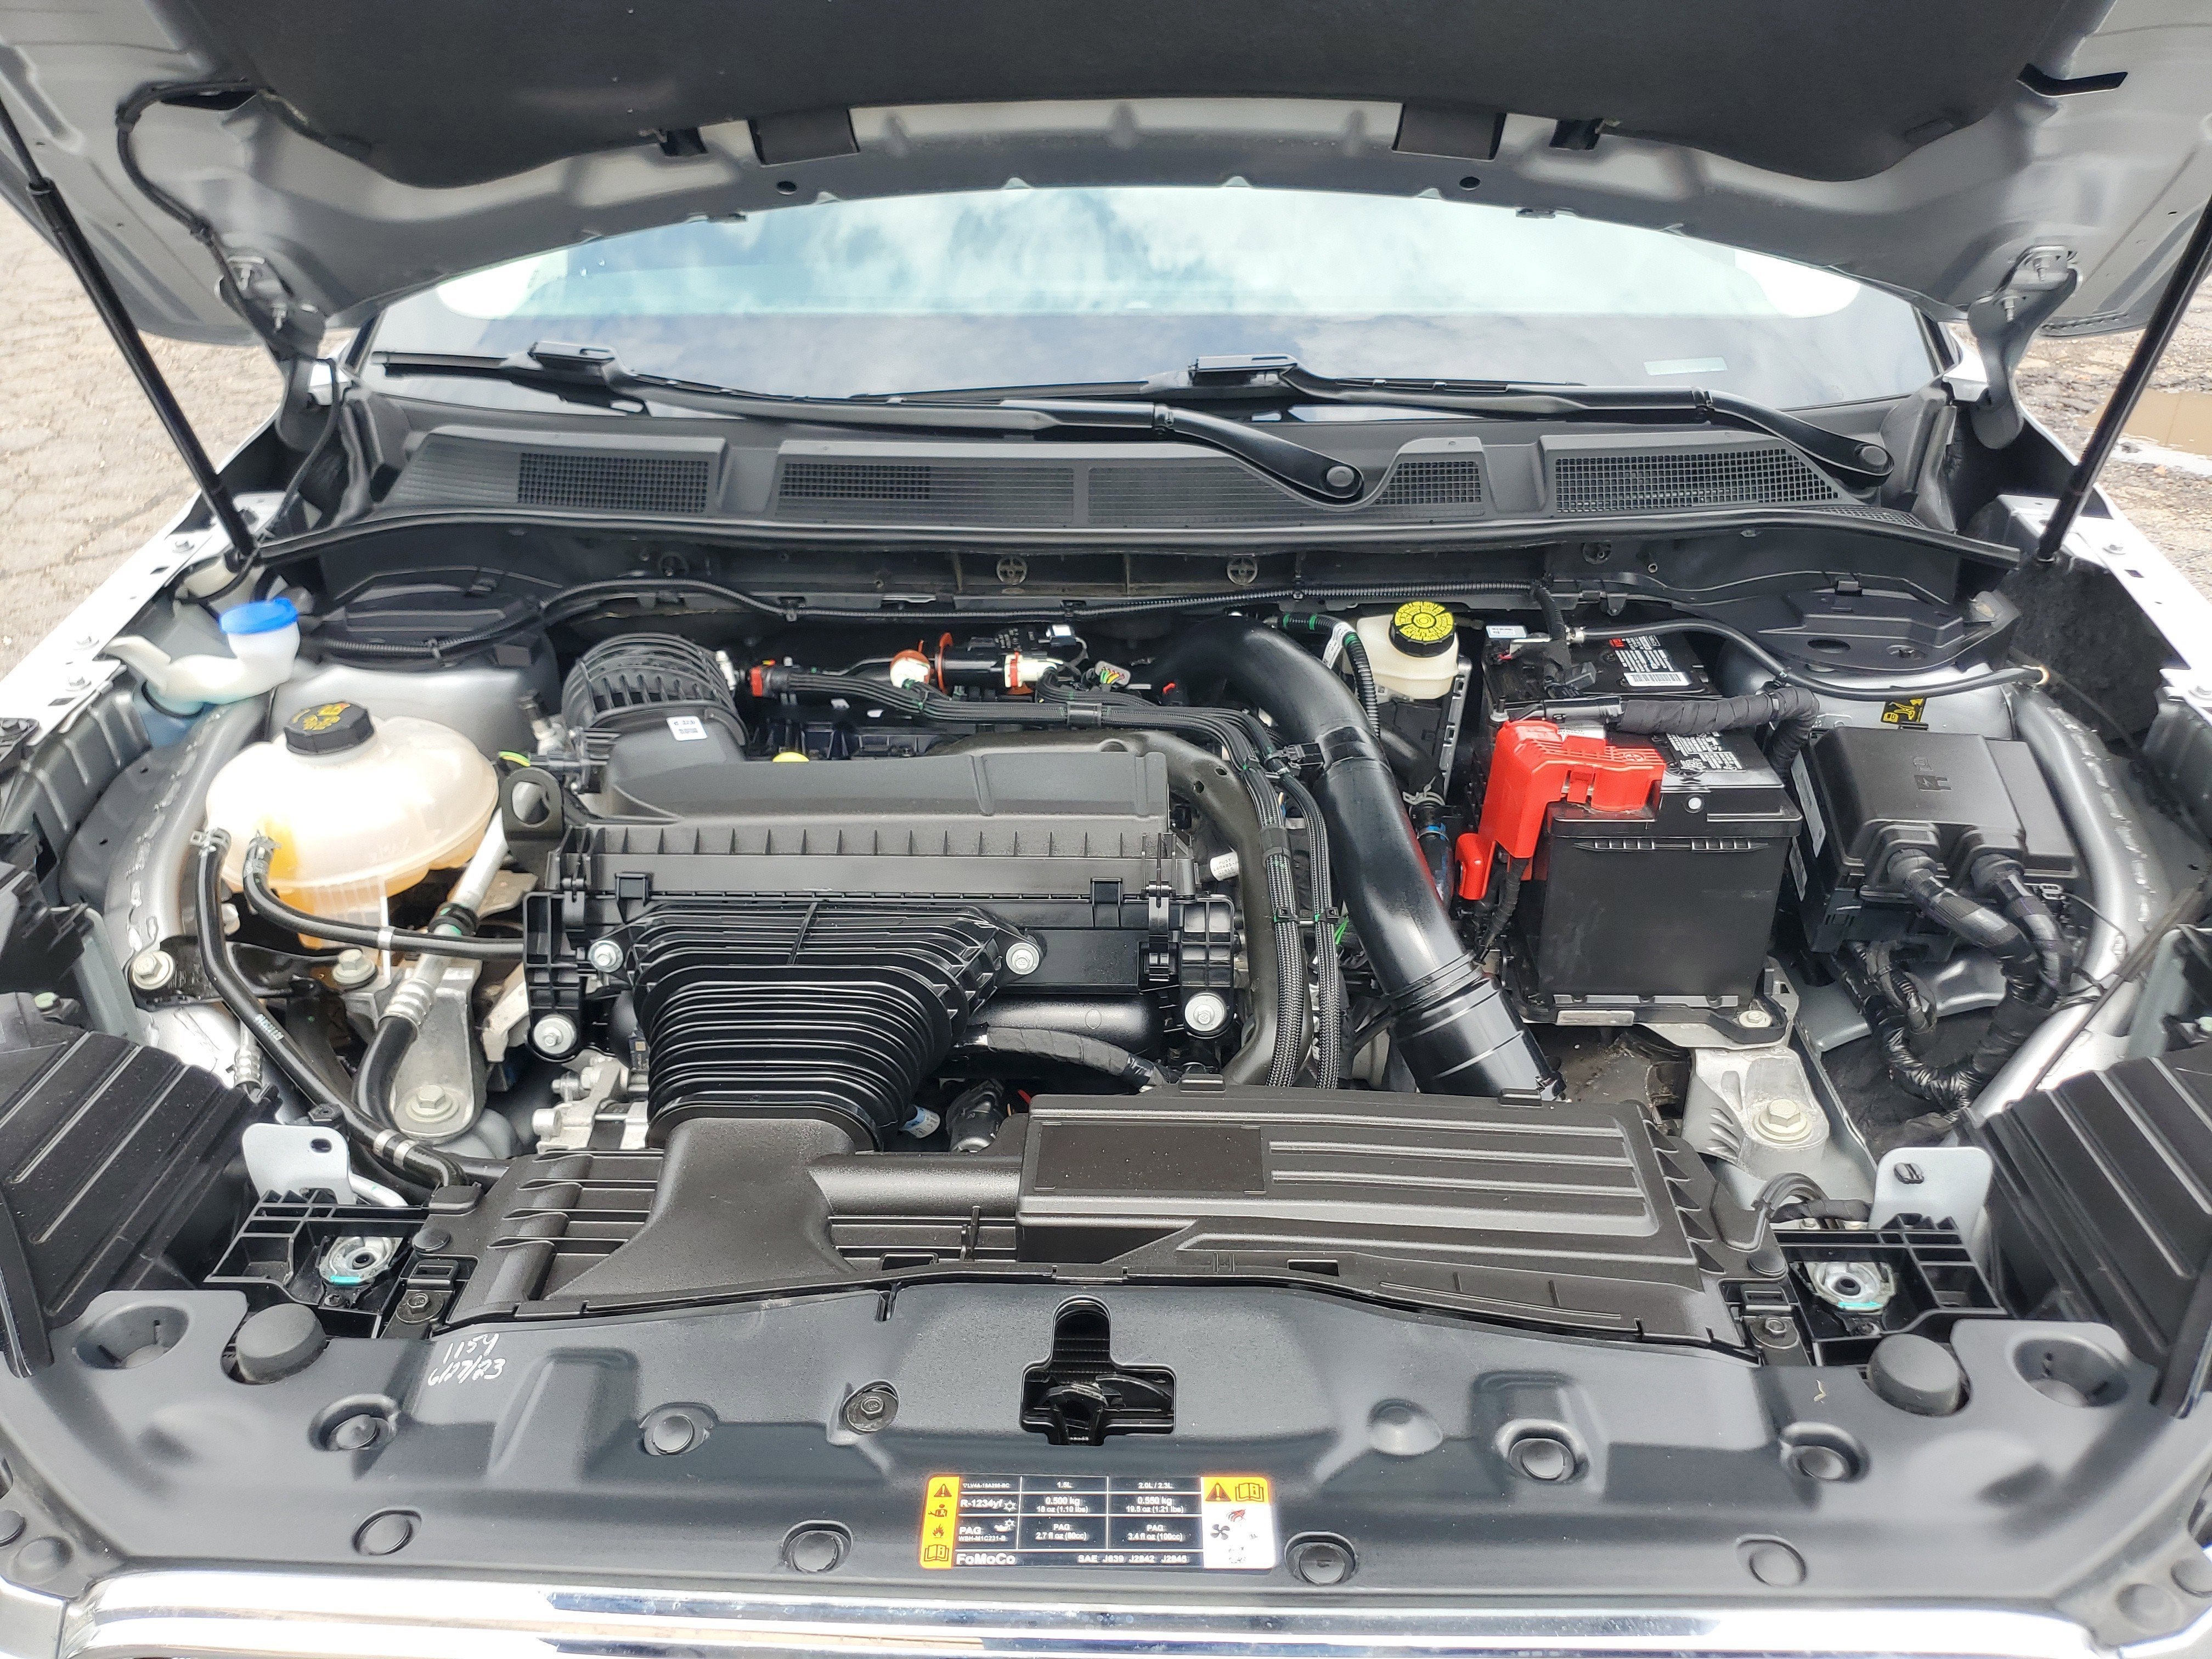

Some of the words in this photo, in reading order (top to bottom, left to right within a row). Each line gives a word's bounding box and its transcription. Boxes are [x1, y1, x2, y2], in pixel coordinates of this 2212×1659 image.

[960, 1499, 1003, 1510] R-1234yf
[1045, 1496, 1068, 1505] 0.500
[1069, 1496, 1080, 1506] kg
[1137, 1496, 1160, 1504] 0.550
[1161, 1496, 1172, 1506] kg
[1057, 1505, 1074, 1514] (1.10
[1075, 1505, 1088, 1514] lbs)
[1153, 1505, 1169, 1514] (1.21
[1170, 1505, 1184, 1514] lbs)
[959, 1526, 982, 1535] PAG
[1127, 1532, 1139, 1541] 3.4
[1156, 1532, 1183, 1542] (100cc)
[956, 1553, 1016, 1565] FoMoCo
[1078, 1554, 1098, 1562] SAE
[1102, 1554, 1125, 1562] J639
